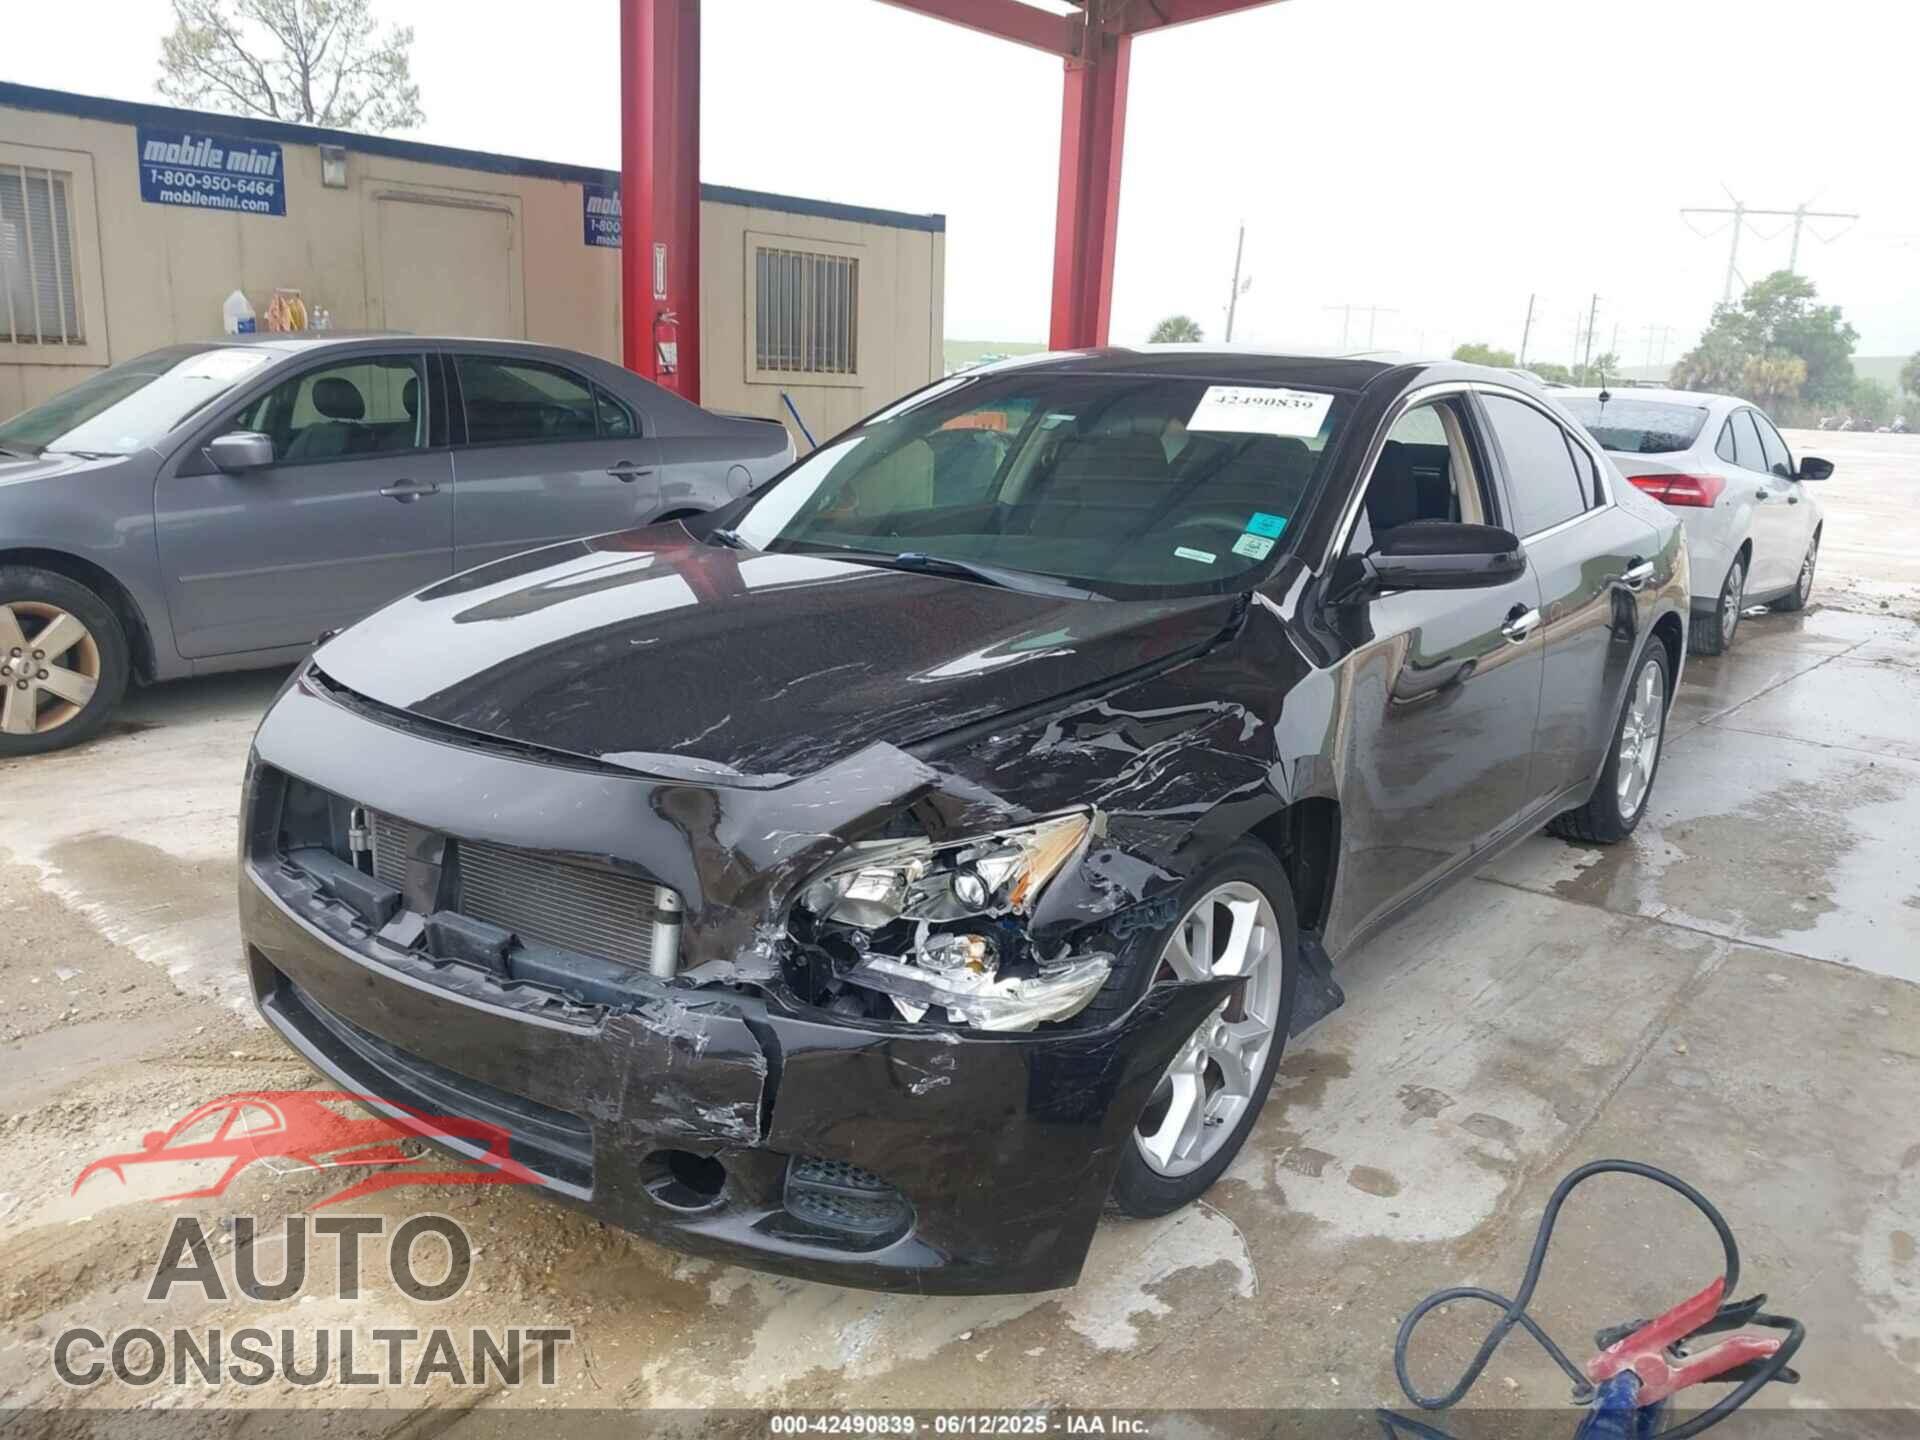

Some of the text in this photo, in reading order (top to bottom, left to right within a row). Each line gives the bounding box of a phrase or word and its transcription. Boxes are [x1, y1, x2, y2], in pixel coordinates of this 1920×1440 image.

[143, 134, 277, 175] mobile mini
[151, 169, 275, 197] 1-800-950-6464
[160, 189, 270, 212] mobilemini.com
